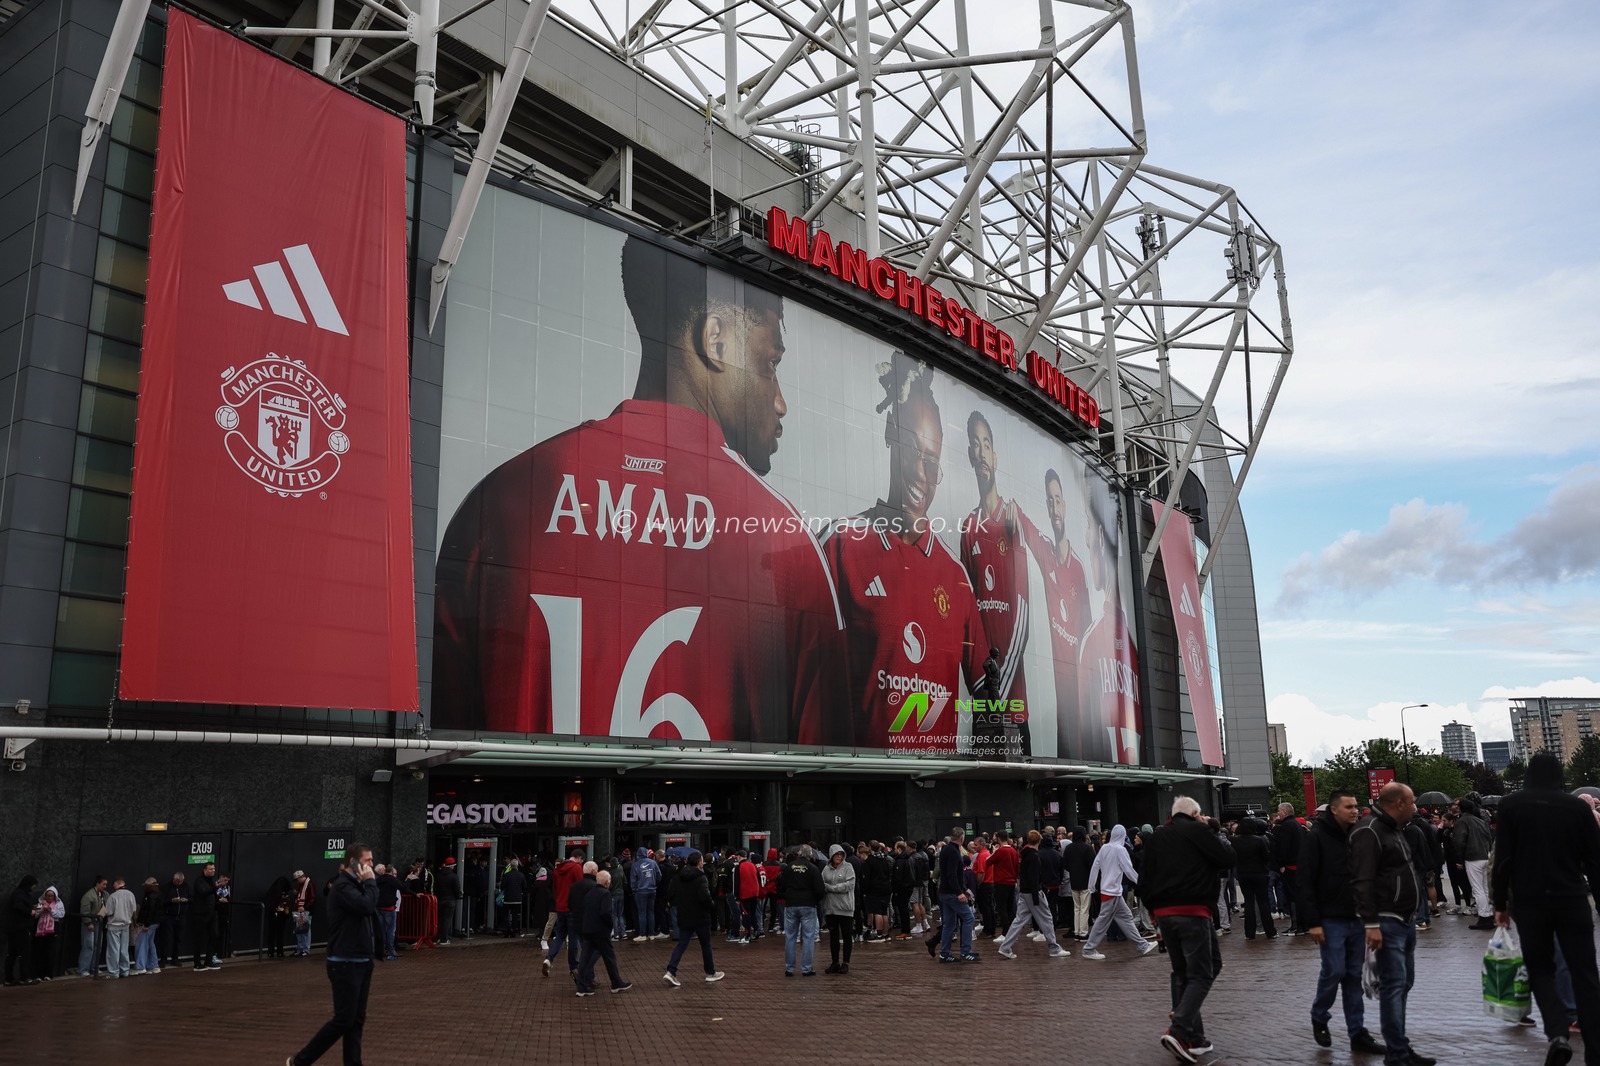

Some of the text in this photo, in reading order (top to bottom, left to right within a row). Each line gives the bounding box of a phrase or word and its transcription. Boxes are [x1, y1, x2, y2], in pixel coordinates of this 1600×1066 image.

[767, 206, 1100, 429] MANCHESTER UNITED
[230, 364, 337, 421] MANCHESTER
[246, 455, 322, 487] UNITED
[625, 457, 664, 471] UNITED
[544, 473, 716, 550] AMAD
[976, 597, 1010, 614] Snapdragon
[1051, 616, 1079, 647] Snapdragon
[530, 593, 711, 741] 16
[877, 669, 948, 701] Snapdragon
[622, 803, 712, 822] ENTRANCE
[191, 842, 213, 854] EX09
[327, 838, 345, 850] EX10
